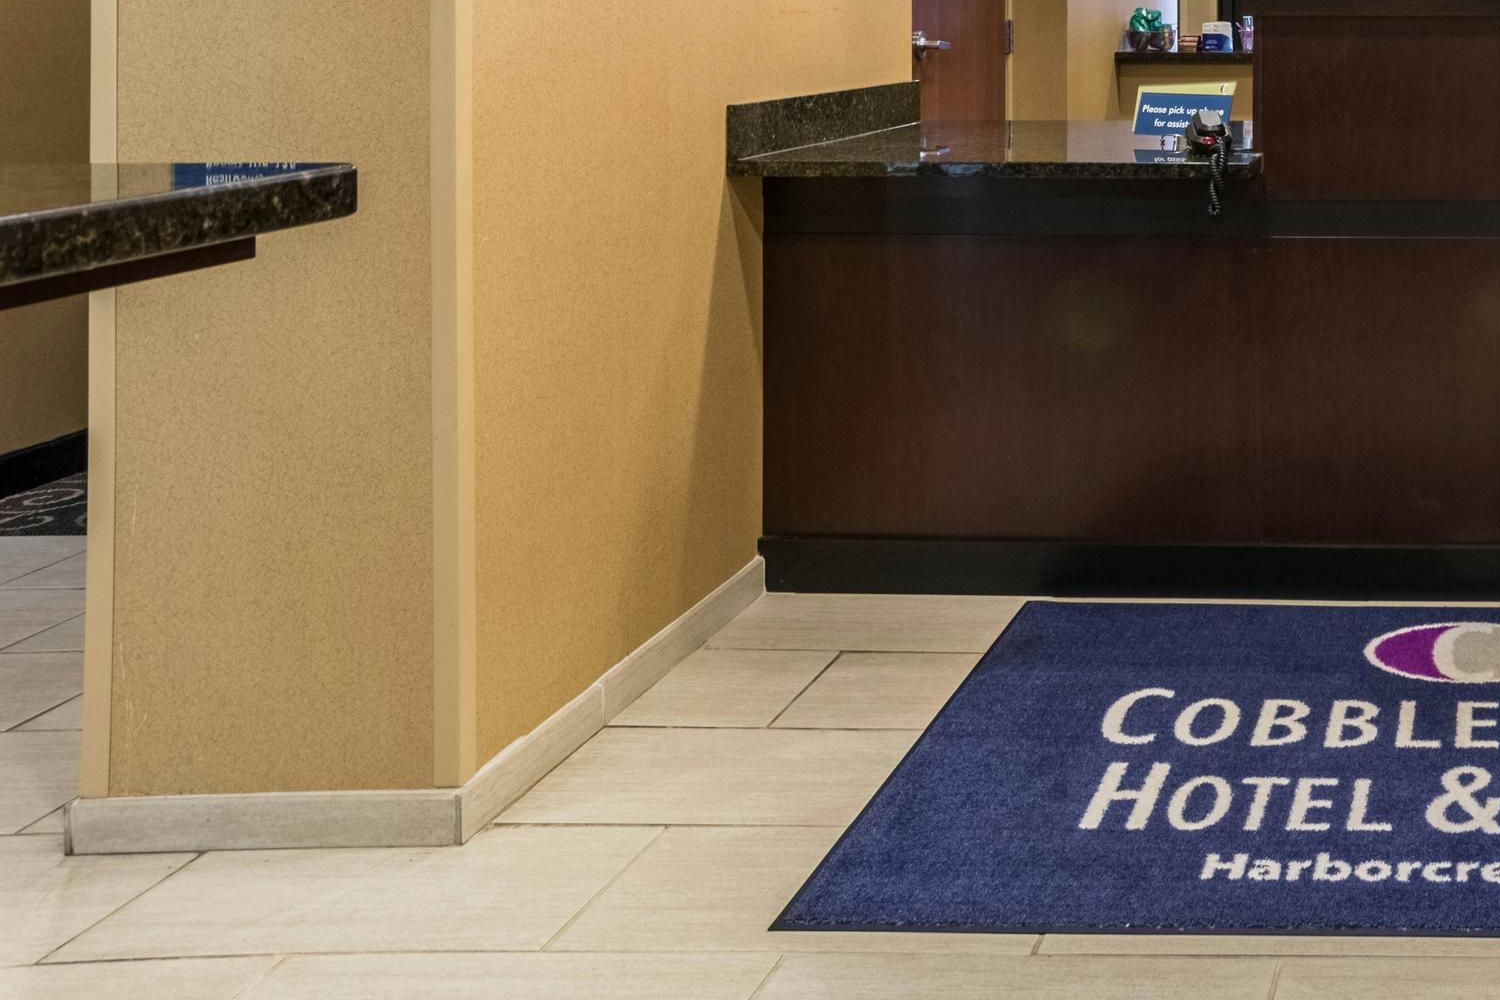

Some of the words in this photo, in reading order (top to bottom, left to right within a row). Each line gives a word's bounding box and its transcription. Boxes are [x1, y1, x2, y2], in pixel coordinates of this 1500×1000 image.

[1142, 105, 1167, 114] Please
[1168, 106, 1185, 115] pick
[1187, 108, 1197, 116] up
[1154, 118, 1166, 127] for
[1167, 120, 1189, 128] assist
[1079, 763, 1392, 832] HOTEL
